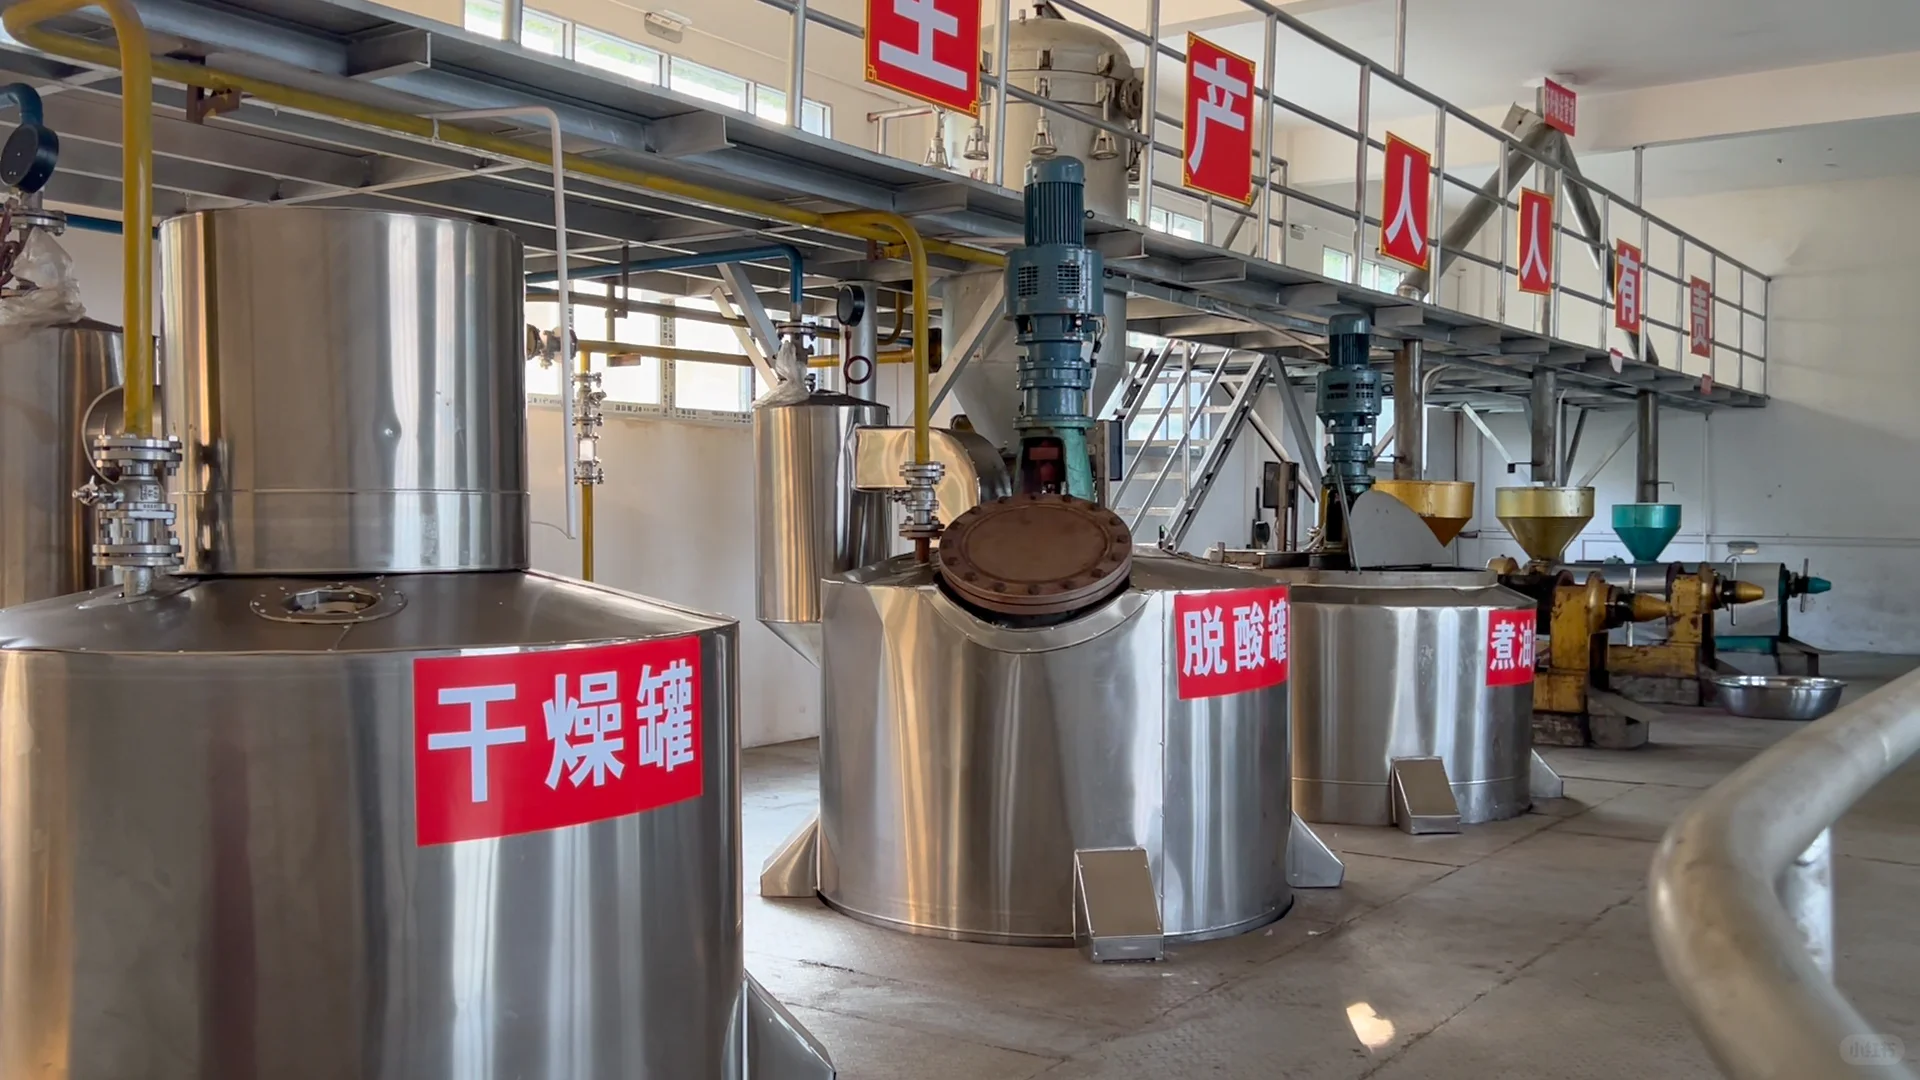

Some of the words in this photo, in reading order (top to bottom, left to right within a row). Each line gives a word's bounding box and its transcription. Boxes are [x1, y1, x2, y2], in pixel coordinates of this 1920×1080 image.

[1188, 57, 1248, 175] 产
[1385, 154, 1424, 256] 人
[1521, 202, 1548, 284] 人
[1618, 249, 1638, 324] 有
[1183, 597, 1286, 677] 脱酸罐
[1490, 619, 1536, 671] 煮油
[428, 659, 694, 803] 干燥罐
